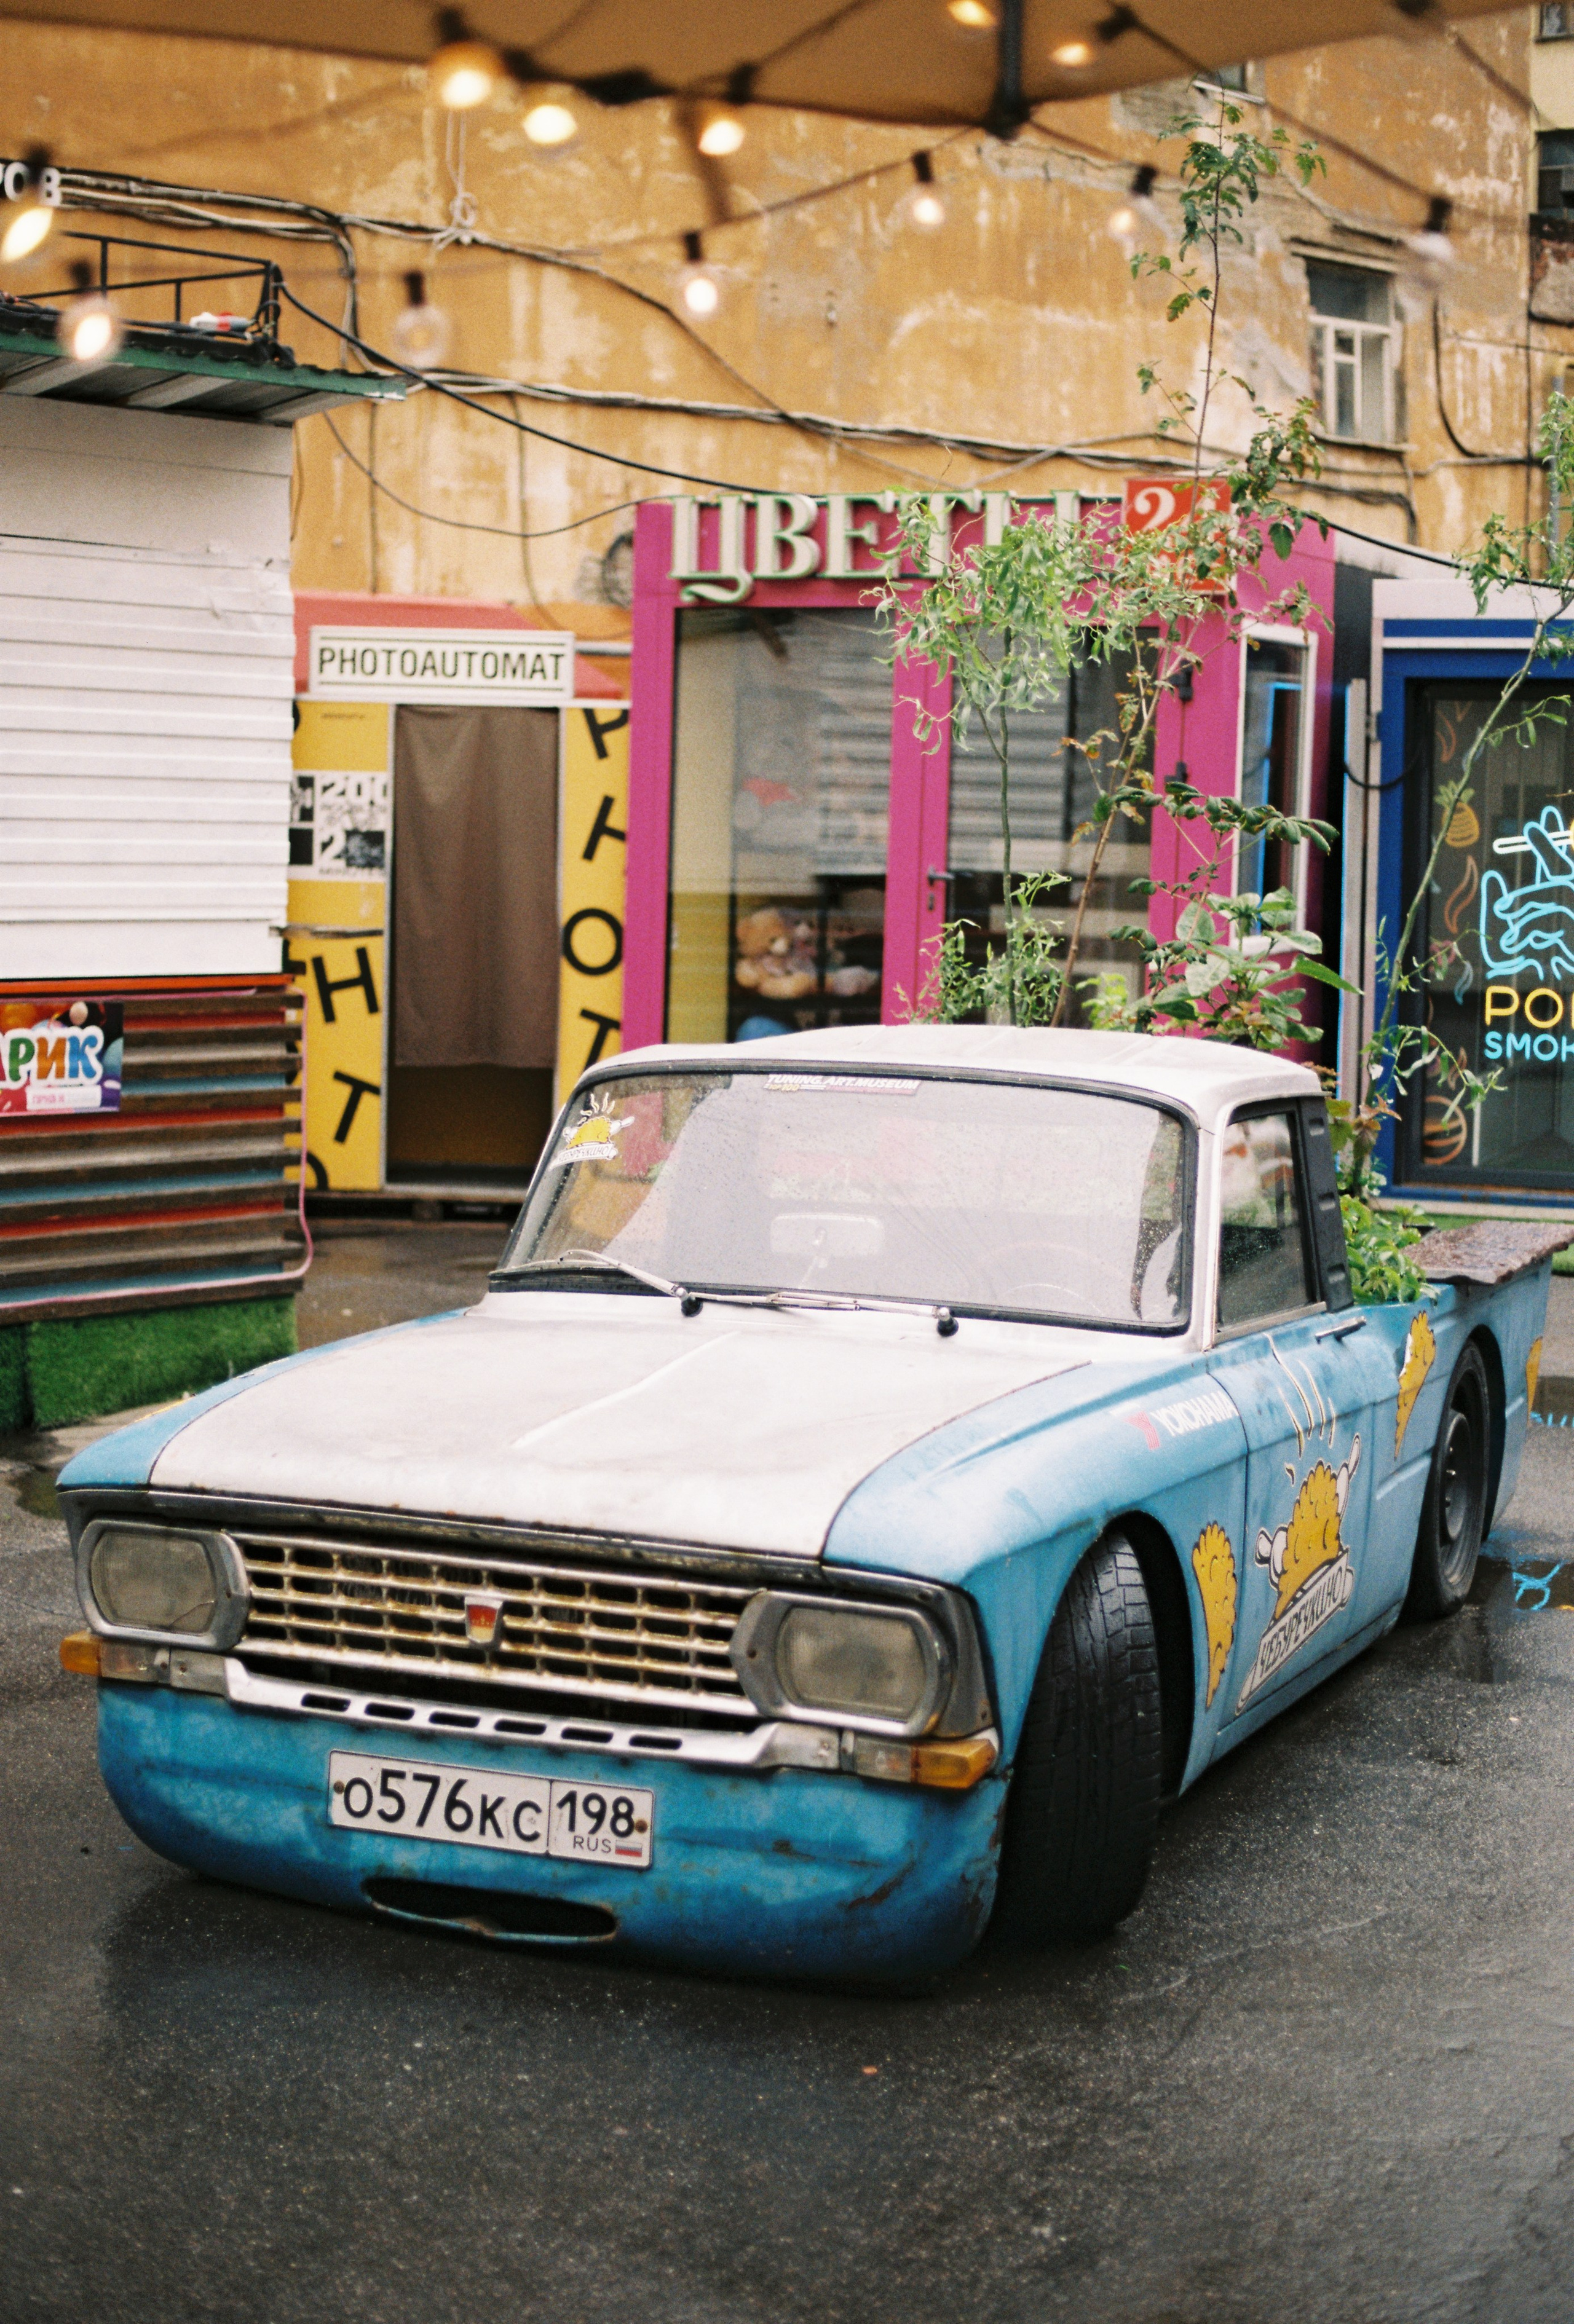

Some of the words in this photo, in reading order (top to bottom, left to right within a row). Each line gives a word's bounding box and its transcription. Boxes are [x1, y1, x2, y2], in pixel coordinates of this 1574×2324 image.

[318, 647, 565, 680] PHOTOAUTOMAT
[1485, 985, 1574, 1030] PO
[0, 1034, 98, 1082] РИК
[1149, 1390, 1240, 1437] YOKOHAMA
[556, 1789, 635, 1838] 198
[572, 1835, 612, 1854] RUS
